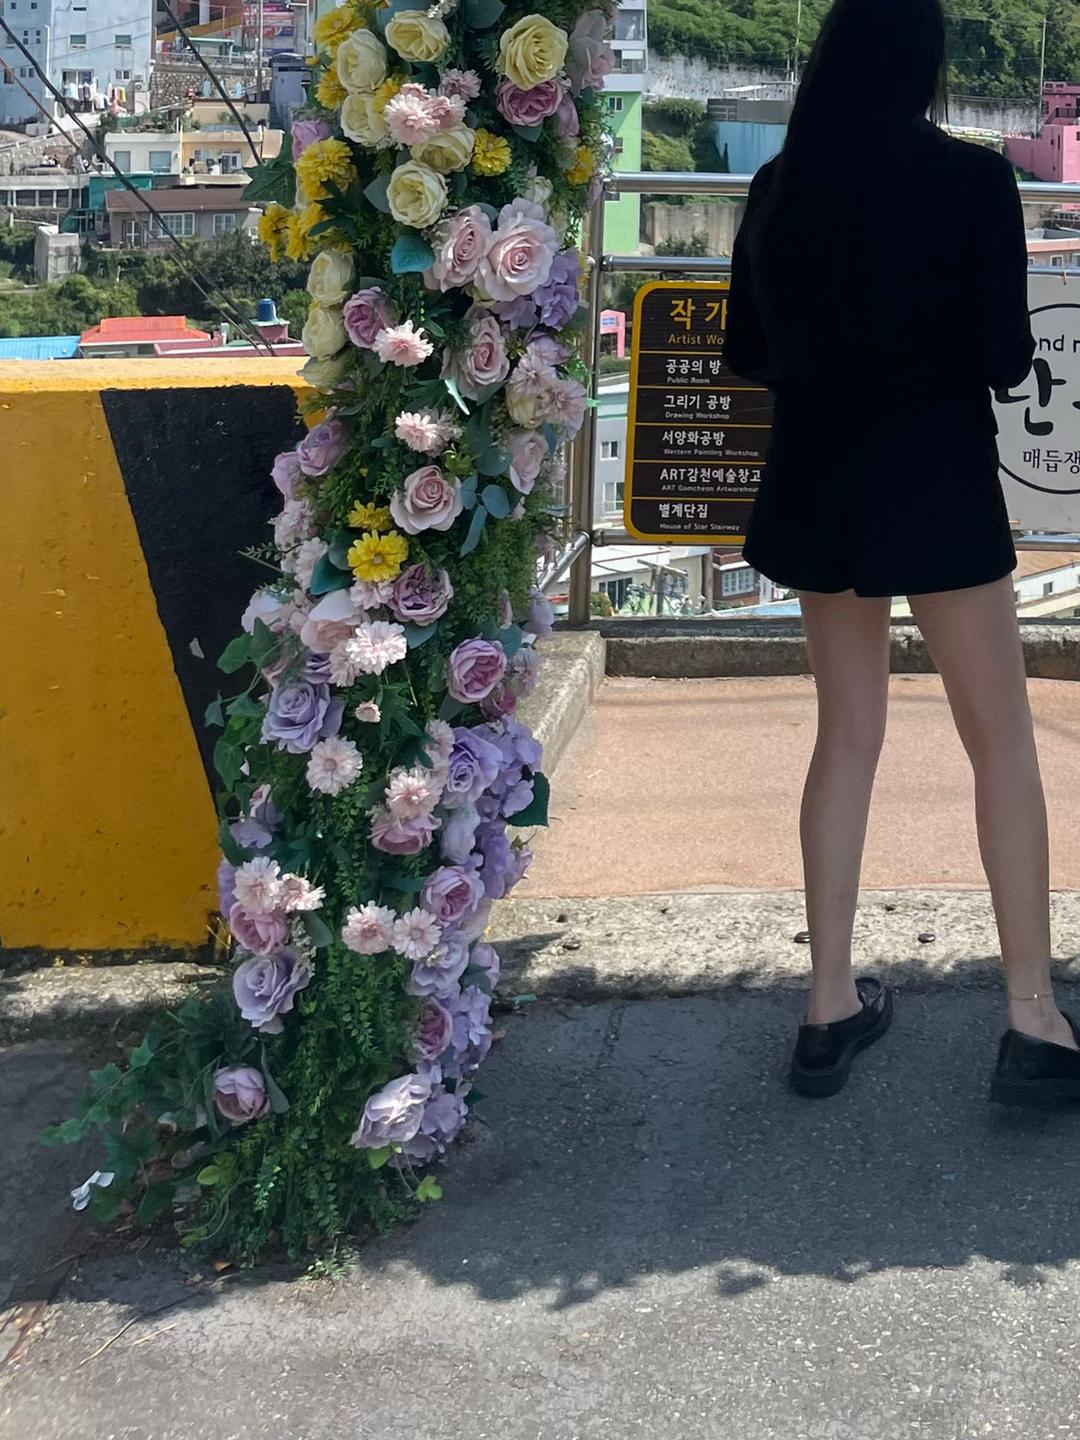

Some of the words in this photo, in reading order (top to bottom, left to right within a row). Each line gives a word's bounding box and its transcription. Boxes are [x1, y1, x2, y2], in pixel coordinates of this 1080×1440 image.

[668, 333, 701, 345] Artist
[706, 334, 725, 345] Wo
[665, 358, 703, 375] 공공의
[709, 359, 722, 375] 방
[666, 376, 689, 384] Public
[663, 394, 700, 410] 그리기
[706, 394, 732, 410] 공방
[665, 411, 694, 419] Drawing
[695, 411, 730, 420] Workshop
[662, 429, 726, 446] 서양화공방
[694, 449, 723, 457] Painting
[724, 449, 760, 458] Workshop
[660, 467, 762, 484] ART감천예술창고
[661, 483, 677, 492] ART
[659, 502, 708, 519] 별계단집
[659, 523, 682, 531] House
[683, 522, 692, 531] of
[694, 523, 708, 531] Star
[709, 523, 741, 532] Stairway
